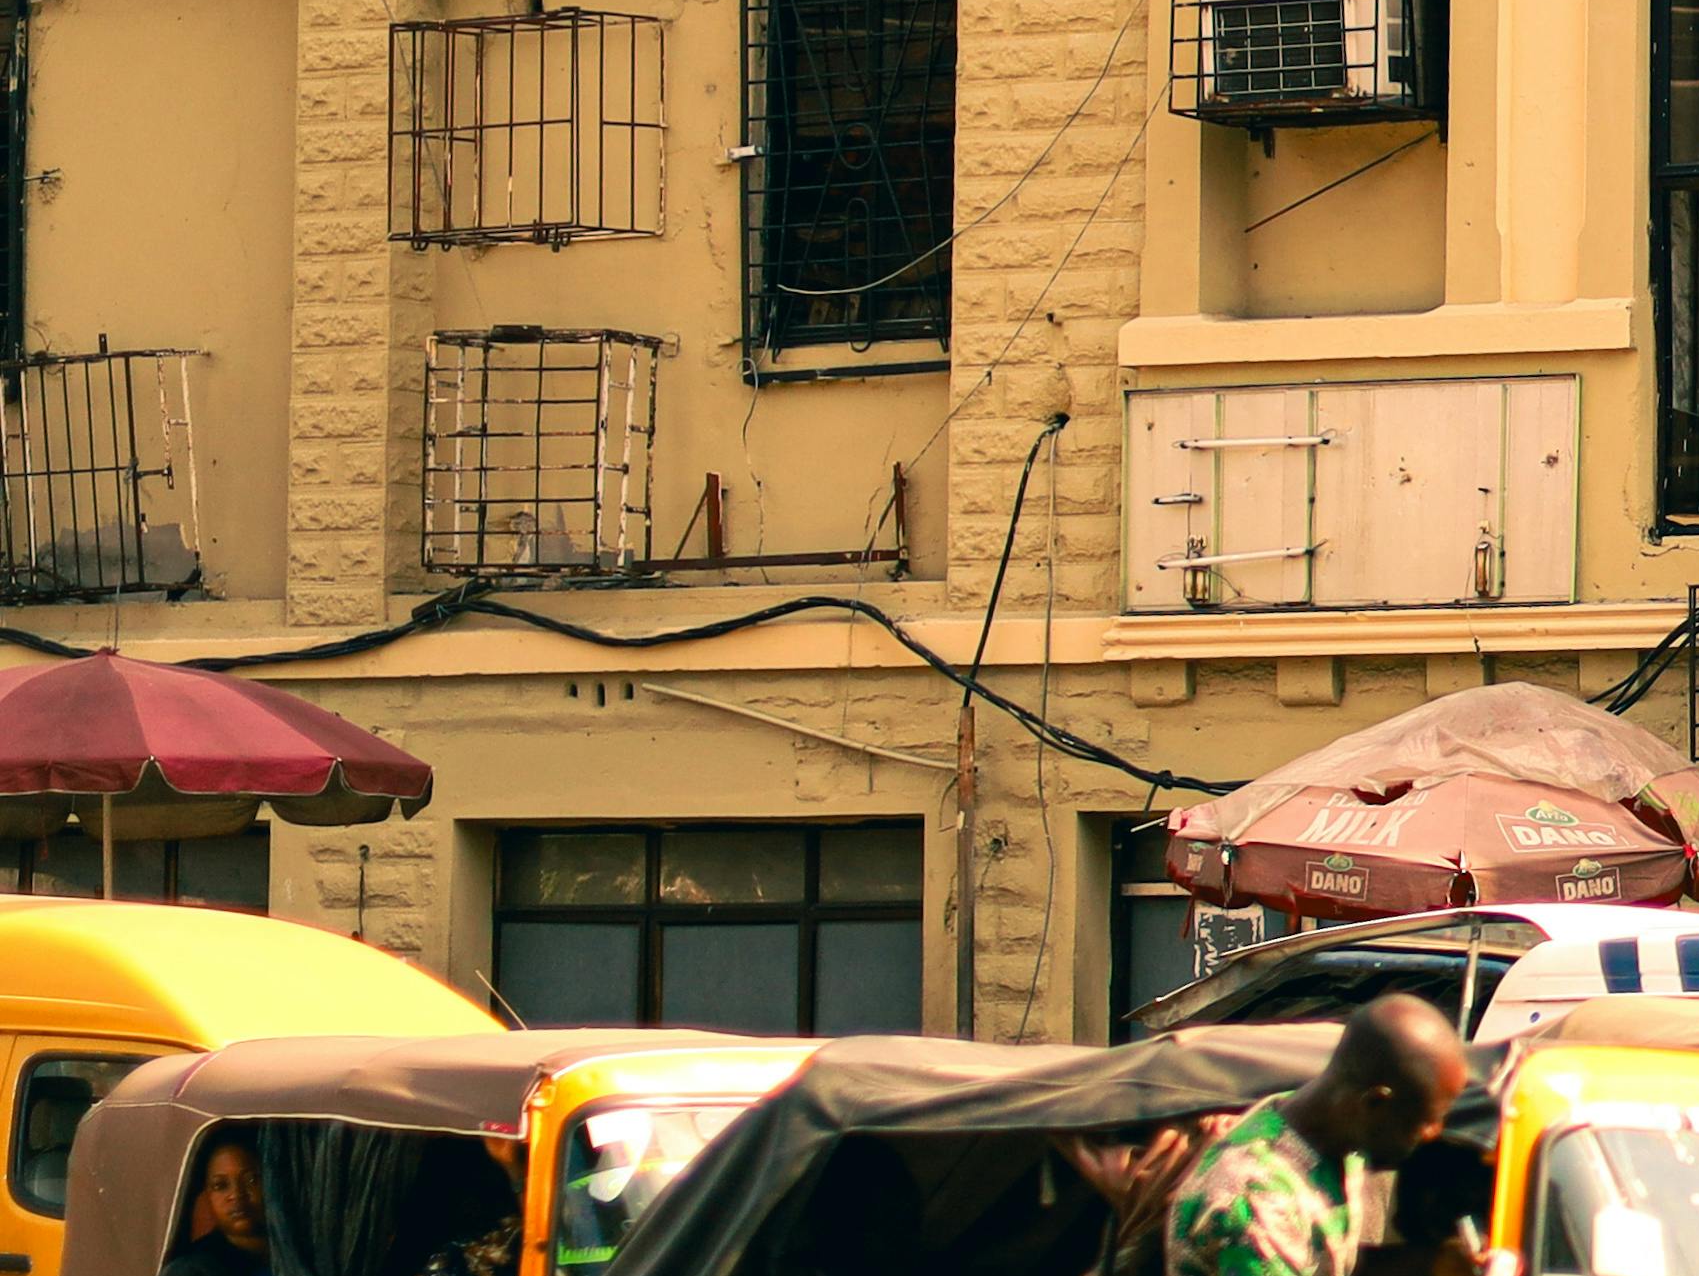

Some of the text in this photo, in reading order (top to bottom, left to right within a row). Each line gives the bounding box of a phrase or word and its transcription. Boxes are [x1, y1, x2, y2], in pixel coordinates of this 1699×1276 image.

[1296, 808, 1417, 847] MILK
[1511, 825, 1616, 846] DANO
[1311, 870, 1362, 895] DANO
[1563, 880, 1615, 901] DANO
